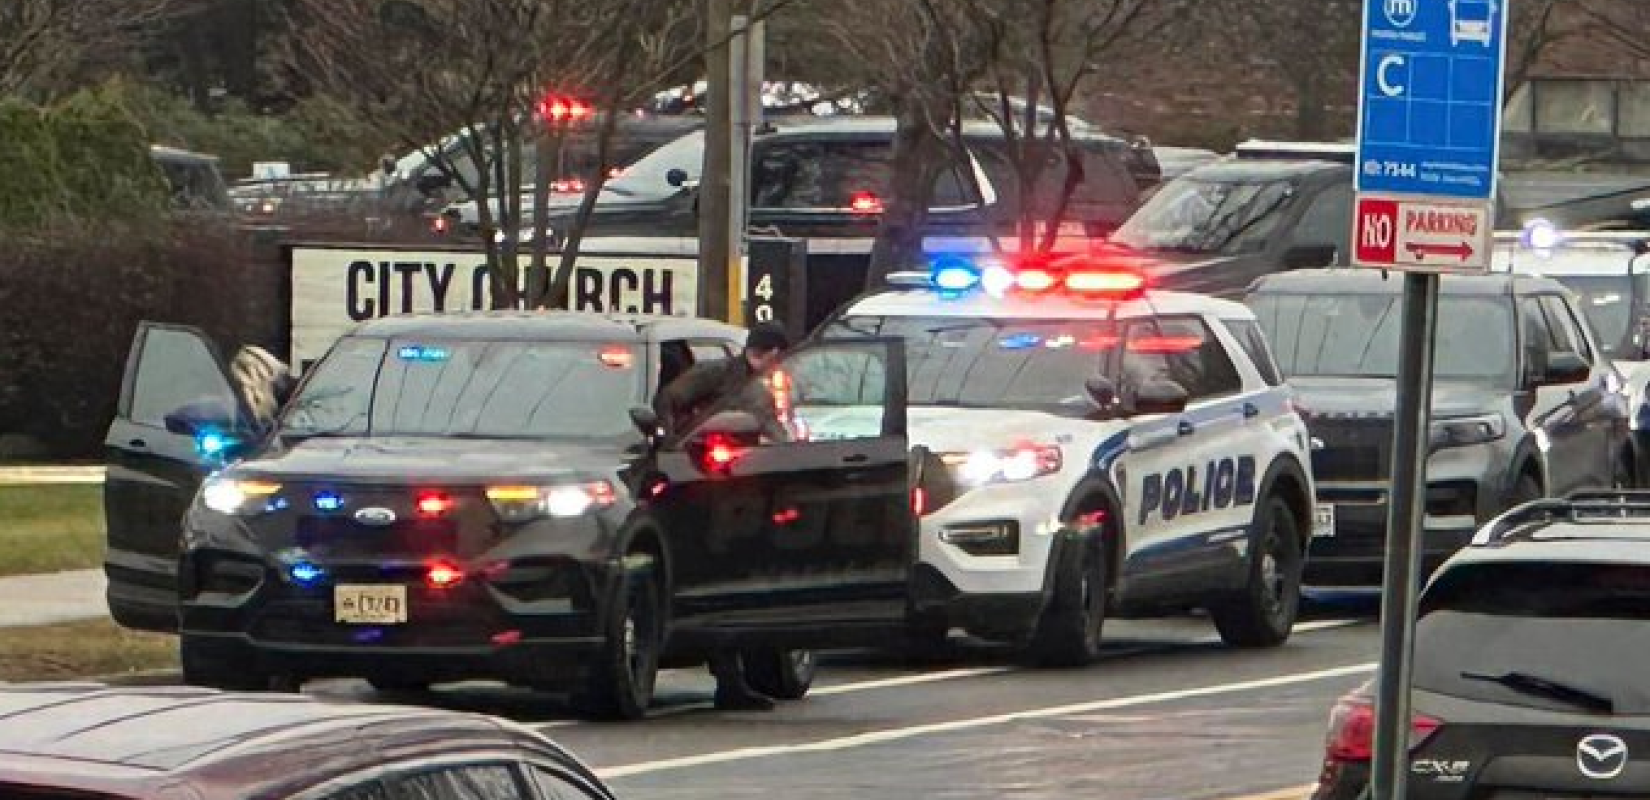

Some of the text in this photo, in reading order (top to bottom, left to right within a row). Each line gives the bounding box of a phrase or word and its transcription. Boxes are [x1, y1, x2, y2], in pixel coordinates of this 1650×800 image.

[1377, 54, 1404, 97] C
[1362, 210, 1477, 249] NO PARKING
[347, 261, 456, 321] CITY
[1140, 455, 1255, 526] POLICE
